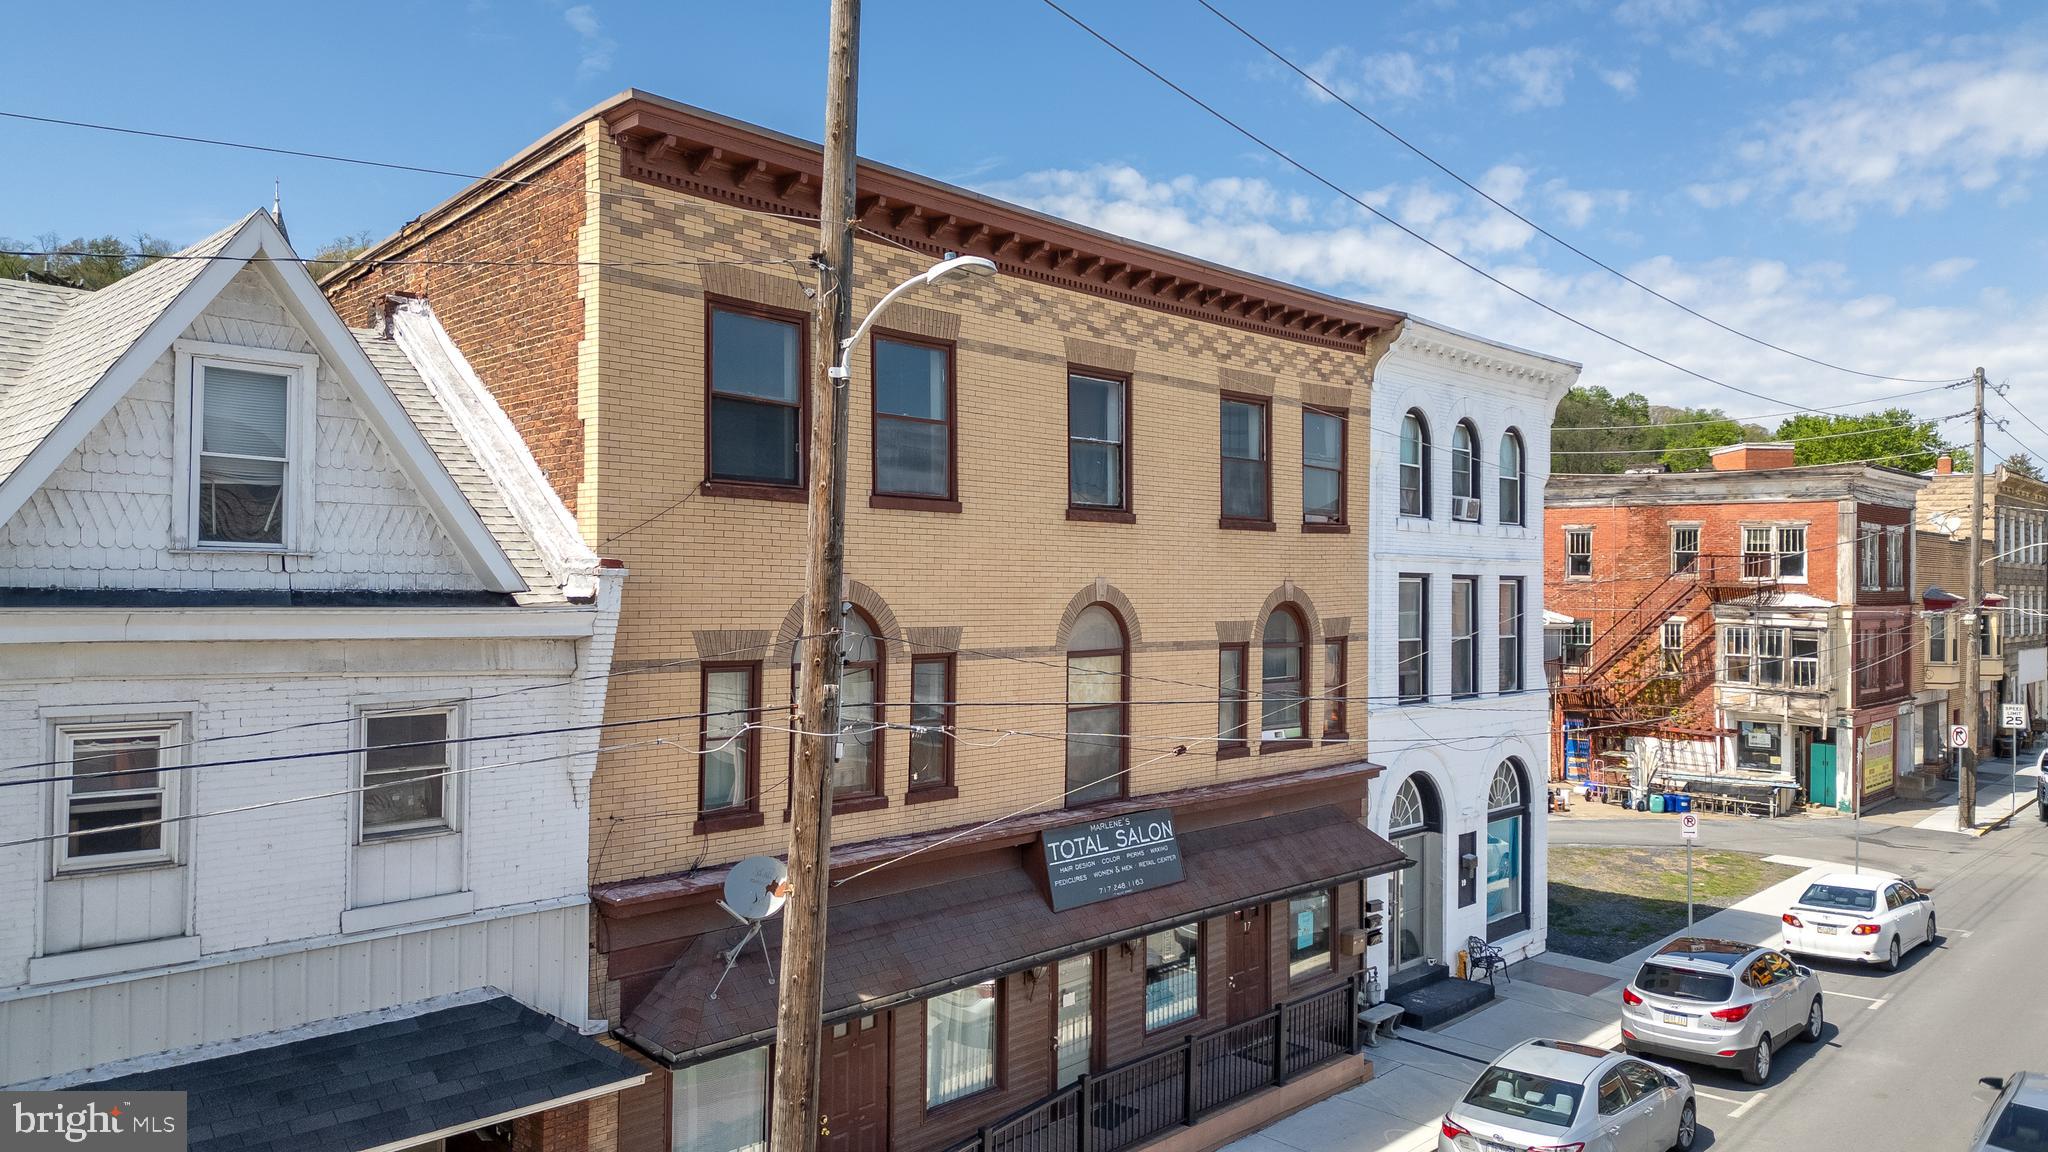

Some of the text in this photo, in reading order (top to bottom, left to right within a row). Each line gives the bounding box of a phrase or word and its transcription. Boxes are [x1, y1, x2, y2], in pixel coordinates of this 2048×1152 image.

[2005, 716, 2023, 725] 25
[1090, 817, 1131, 832] MARLENE'S
[1048, 820, 1174, 861] TOTAL SALON
[1054, 854, 1177, 887] PEDICURES WOMEN & MEN RETAIL CENTER
[1060, 865, 1073, 873] HAIR
[1074, 861, 1096, 870] DESIGN
[1101, 855, 1121, 864] COLOR
[1126, 850, 1145, 858] PERMS
[1244, 921, 1252, 932] 17
